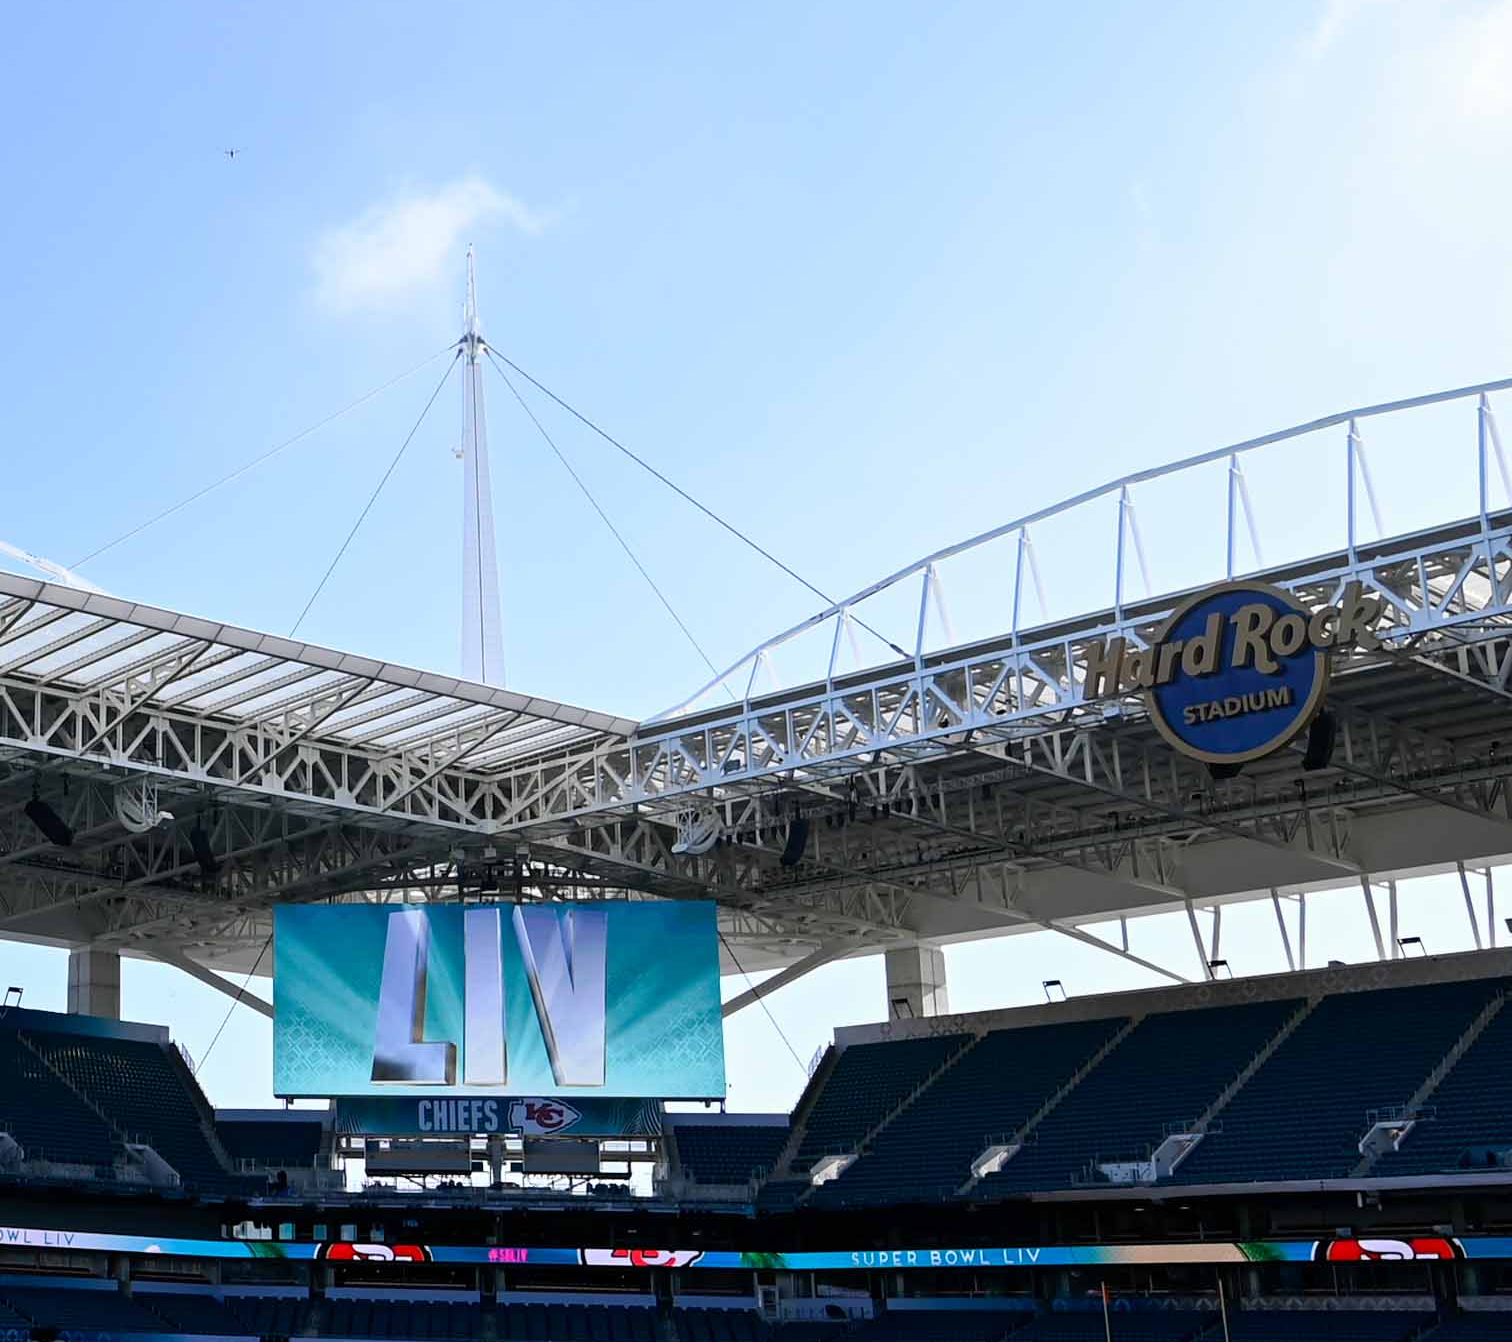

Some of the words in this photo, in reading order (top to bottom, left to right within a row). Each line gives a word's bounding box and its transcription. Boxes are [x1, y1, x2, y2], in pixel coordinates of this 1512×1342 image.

[1083, 611, 1225, 700] Hard
[1230, 580, 1381, 675] Rock
[1183, 686, 1291, 725] STADIUM
[371, 905, 609, 1086] LIV
[418, 1099, 499, 1133] CHIEFS
[44, 1230, 76, 1246] LIV
[850, 1249, 917, 1268] SUPER
[929, 1249, 991, 1267] BOWL
[1002, 1248, 1042, 1265] LIV
